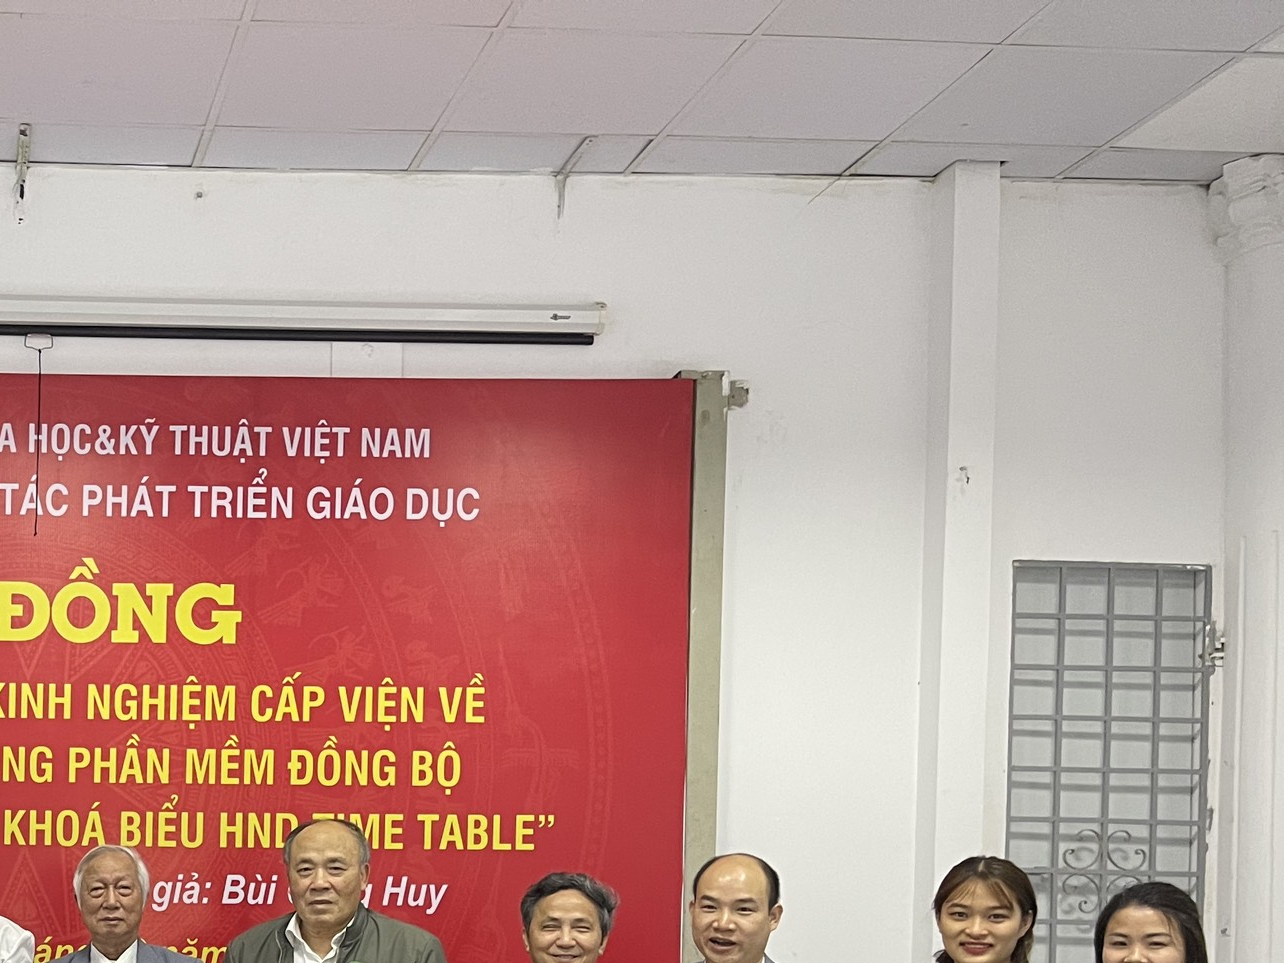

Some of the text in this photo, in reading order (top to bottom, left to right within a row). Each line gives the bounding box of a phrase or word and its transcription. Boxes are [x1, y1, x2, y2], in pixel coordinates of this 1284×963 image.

[28, 417, 160, 462] HỌC&KỸ
[170, 419, 273, 464] THUẬT
[282, 419, 351, 465] VIỆT
[361, 427, 431, 458] NAM
[82, 476, 177, 518] PHÁT
[187, 468, 293, 519] TRIỂN
[306, 479, 395, 521] GIÁO
[407, 487, 481, 528] DỤC
[87, 676, 236, 730] NGHIỆM
[251, 671, 326, 723] CẤP
[338, 677, 425, 730] VIỆN
[439, 673, 486, 724] VỀ
[68, 734, 172, 786] PHẦN
[185, 734, 275, 786] MỀM
[288, 734, 397, 788] ĐỒNG
[412, 740, 461, 795] BỘ
[3, 801, 106, 847] KHOÁ
[120, 794, 205, 848] BIỂU
[219, 812, 299, 849] HND
[312, 812, 404, 850] ME
[416, 813, 555, 851] TABLE”
[151, 872, 212, 913] giả:
[221, 872, 278, 906] Bùi
[381, 875, 449, 915] Huy
